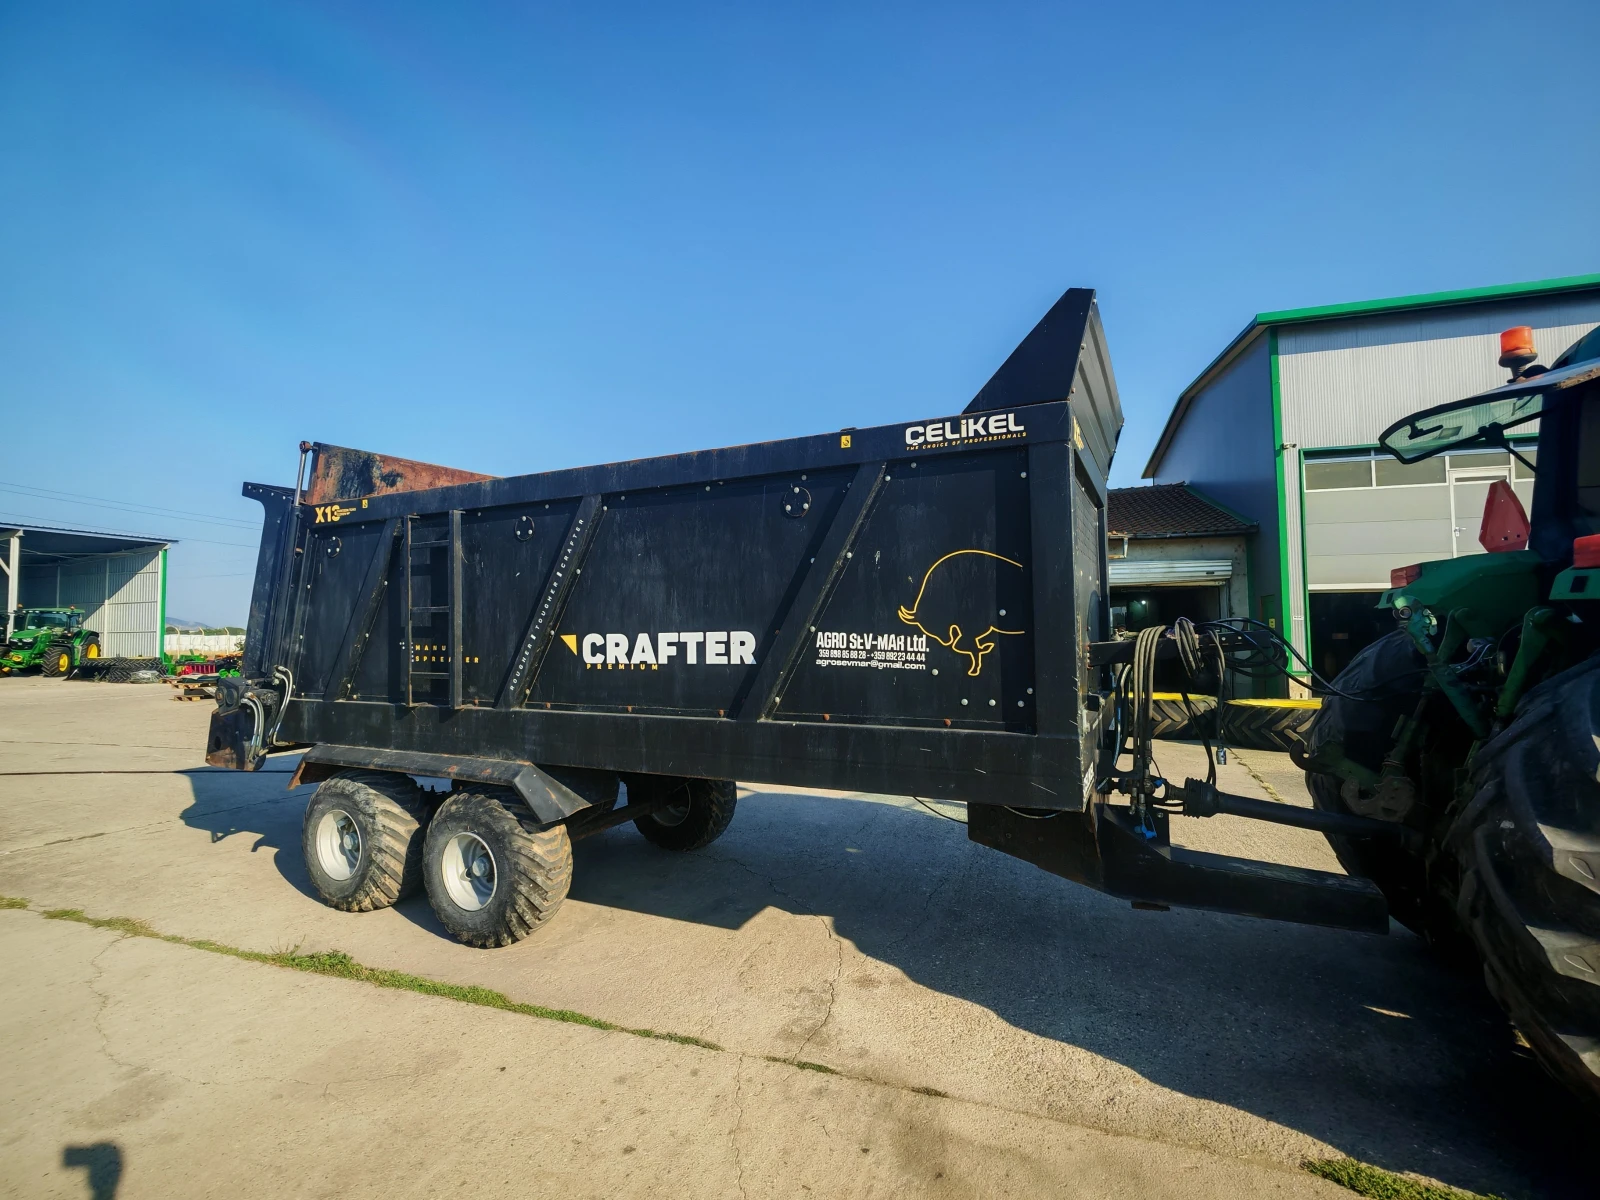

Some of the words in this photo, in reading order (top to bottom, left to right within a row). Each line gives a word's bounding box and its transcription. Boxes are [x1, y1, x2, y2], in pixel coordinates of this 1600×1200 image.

[964, 431, 1027, 444] PROFESSIONALS
[509, 643, 533, 691] ROUGHER
[535, 581, 559, 630] TOUGHER
[560, 519, 585, 569] CRAFTER
[582, 631, 757, 665] CRAFTER
[816, 631, 847, 649] AGRO
[906, 634, 930, 652] Ltd.
[818, 648, 830, 658] 359
[858, 650, 867, 660] 28
[906, 652, 915, 662] 44
[916, 653, 926, 662] 44
[586, 663, 659, 671] PREMIUM
[815, 658, 926, 670] agrosevmar@gmail.com
